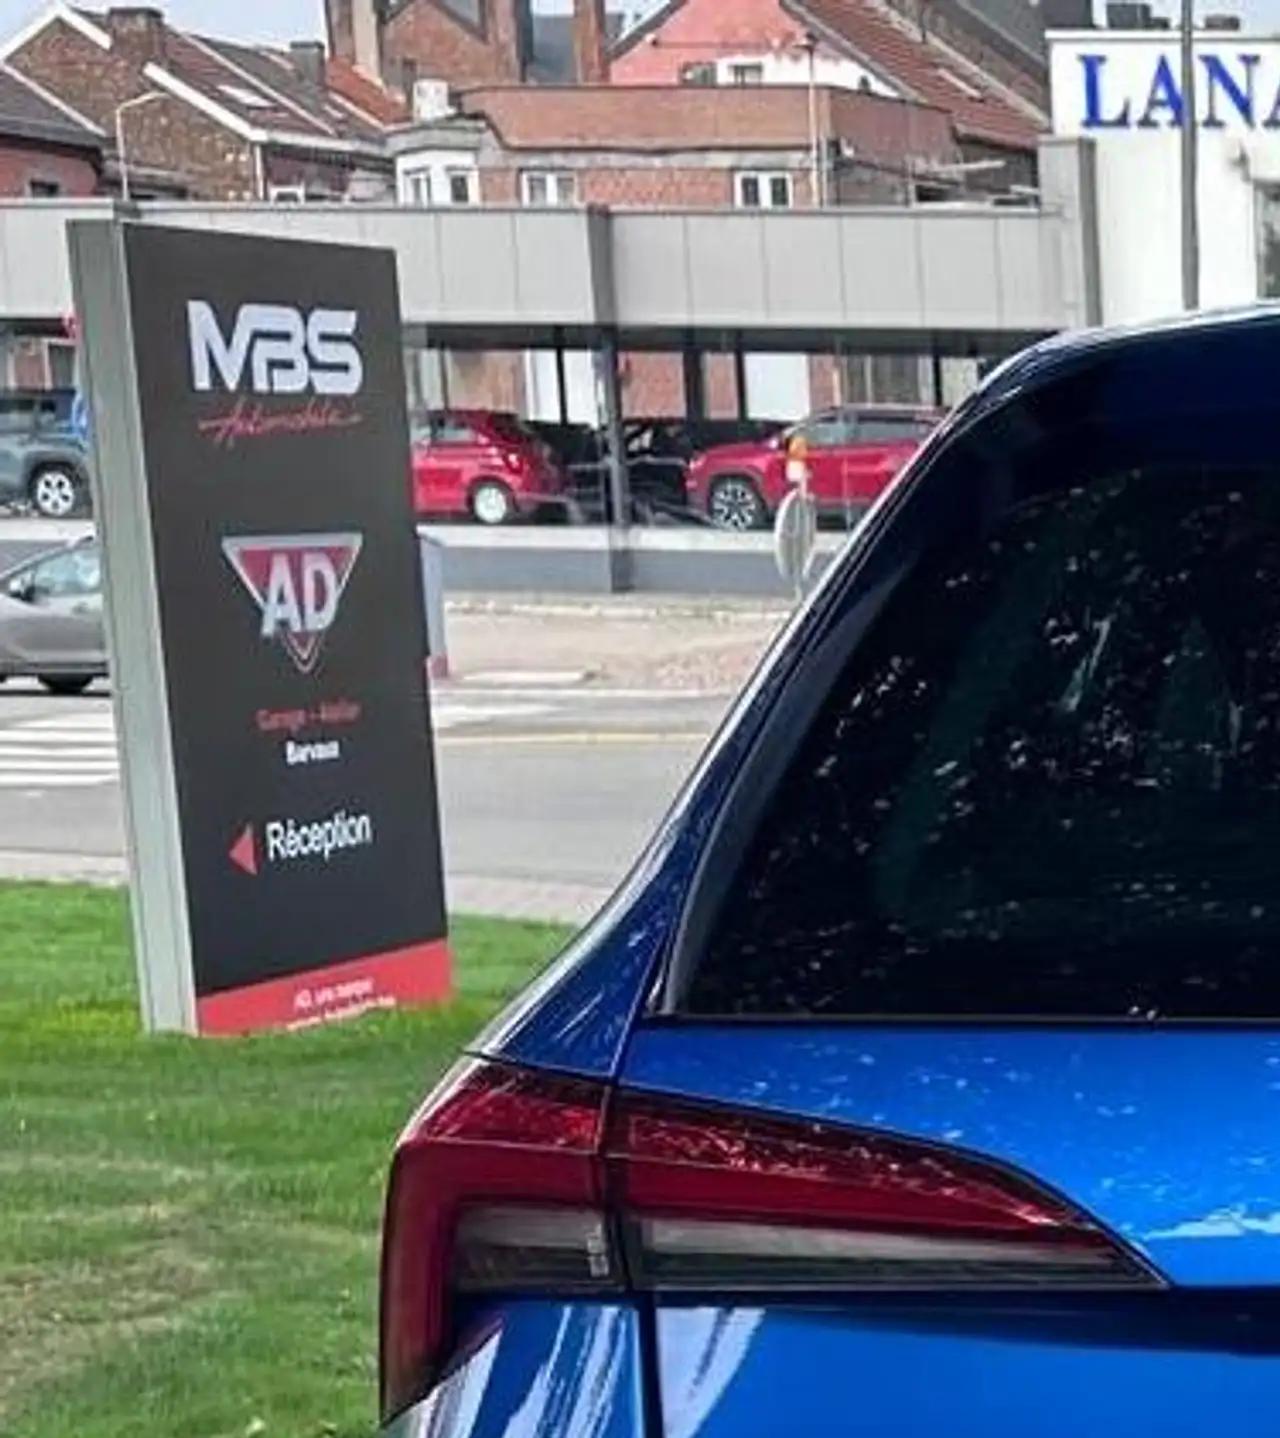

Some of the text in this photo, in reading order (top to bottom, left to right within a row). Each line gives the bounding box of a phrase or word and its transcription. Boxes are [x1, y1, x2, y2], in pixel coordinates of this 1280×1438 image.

[187, 299, 363, 394] MBS
[261, 552, 338, 635] AD
[266, 810, 372, 862] Réception
